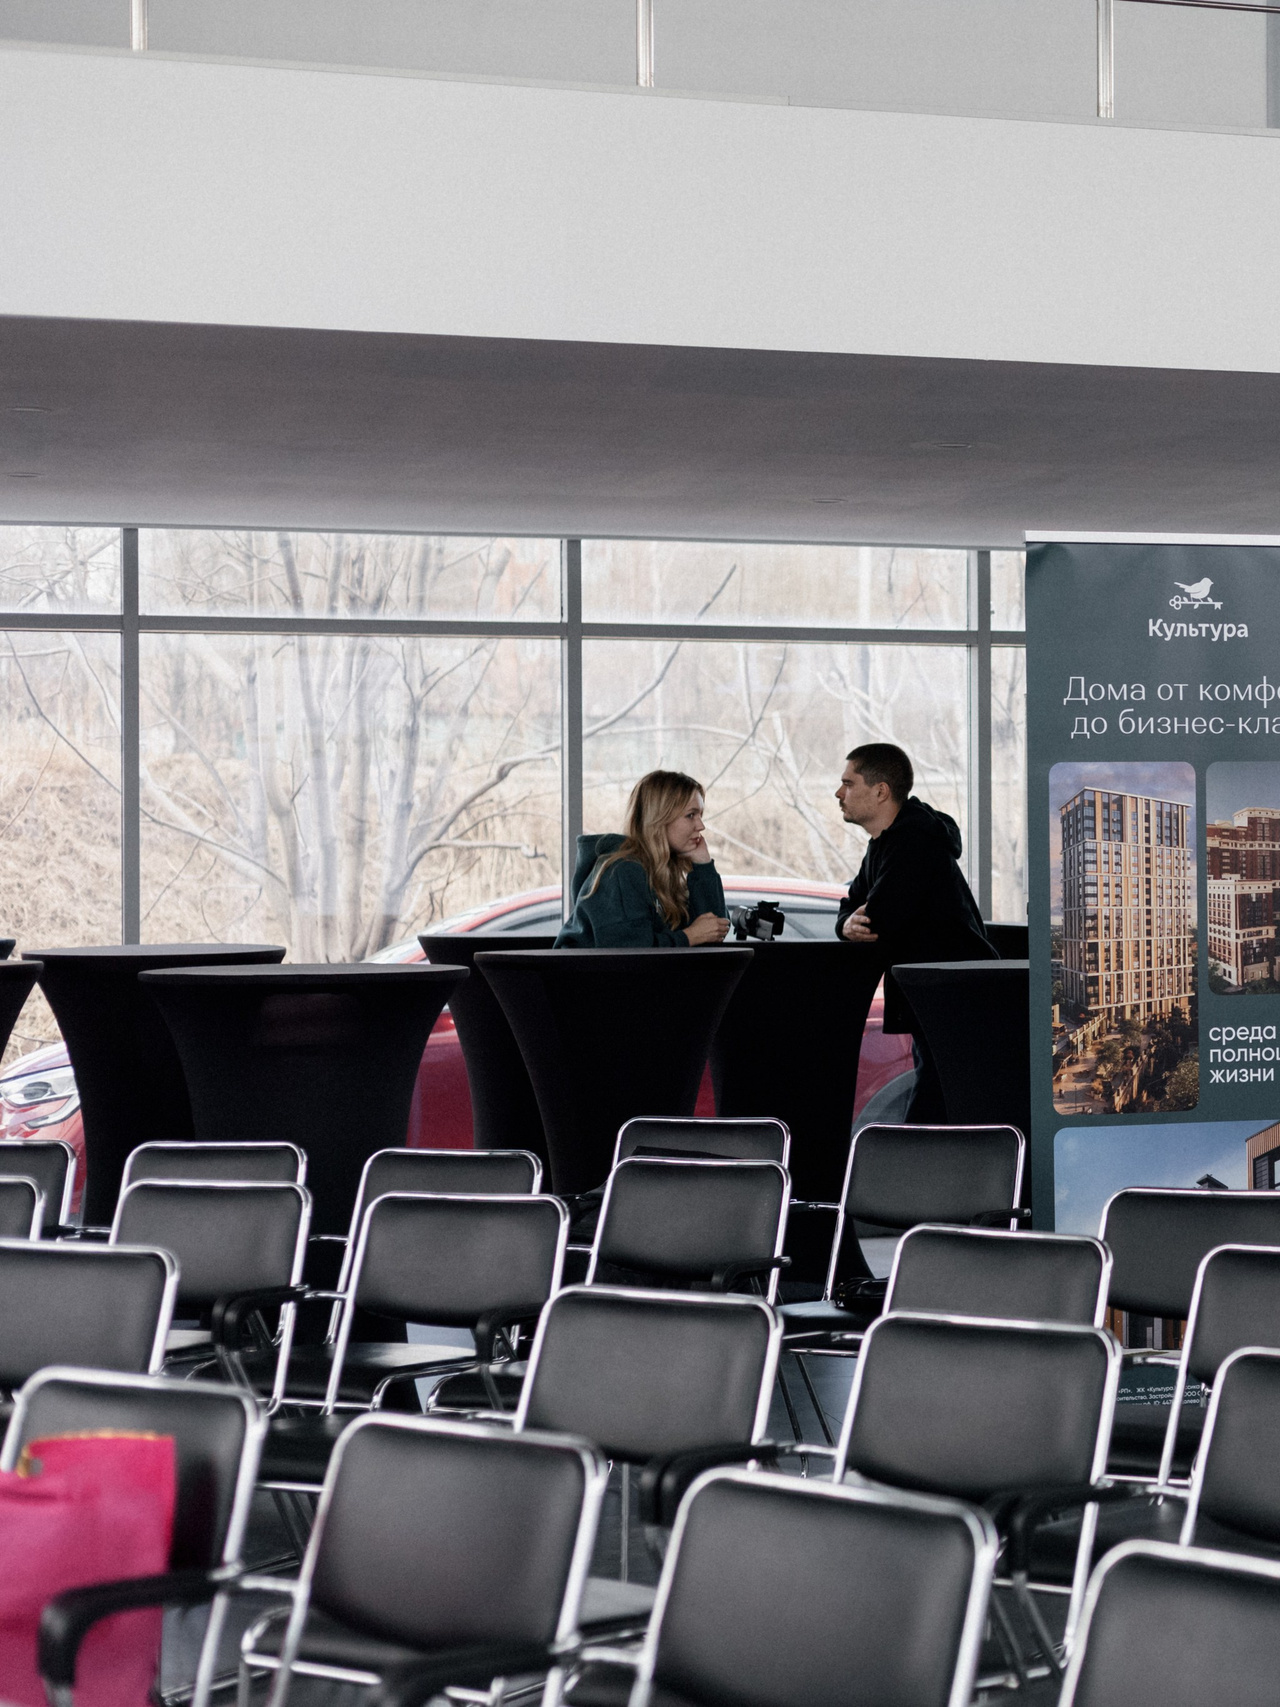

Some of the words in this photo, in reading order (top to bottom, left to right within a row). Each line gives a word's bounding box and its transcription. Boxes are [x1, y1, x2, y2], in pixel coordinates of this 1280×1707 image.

[1148, 618, 1249, 642] Культура
[1063, 676, 1146, 706] Дома
[1157, 683, 1189, 702] от
[1071, 716, 1108, 739] до
[1209, 1025, 1276, 1045] среда
[1209, 1067, 1275, 1083] жизни
